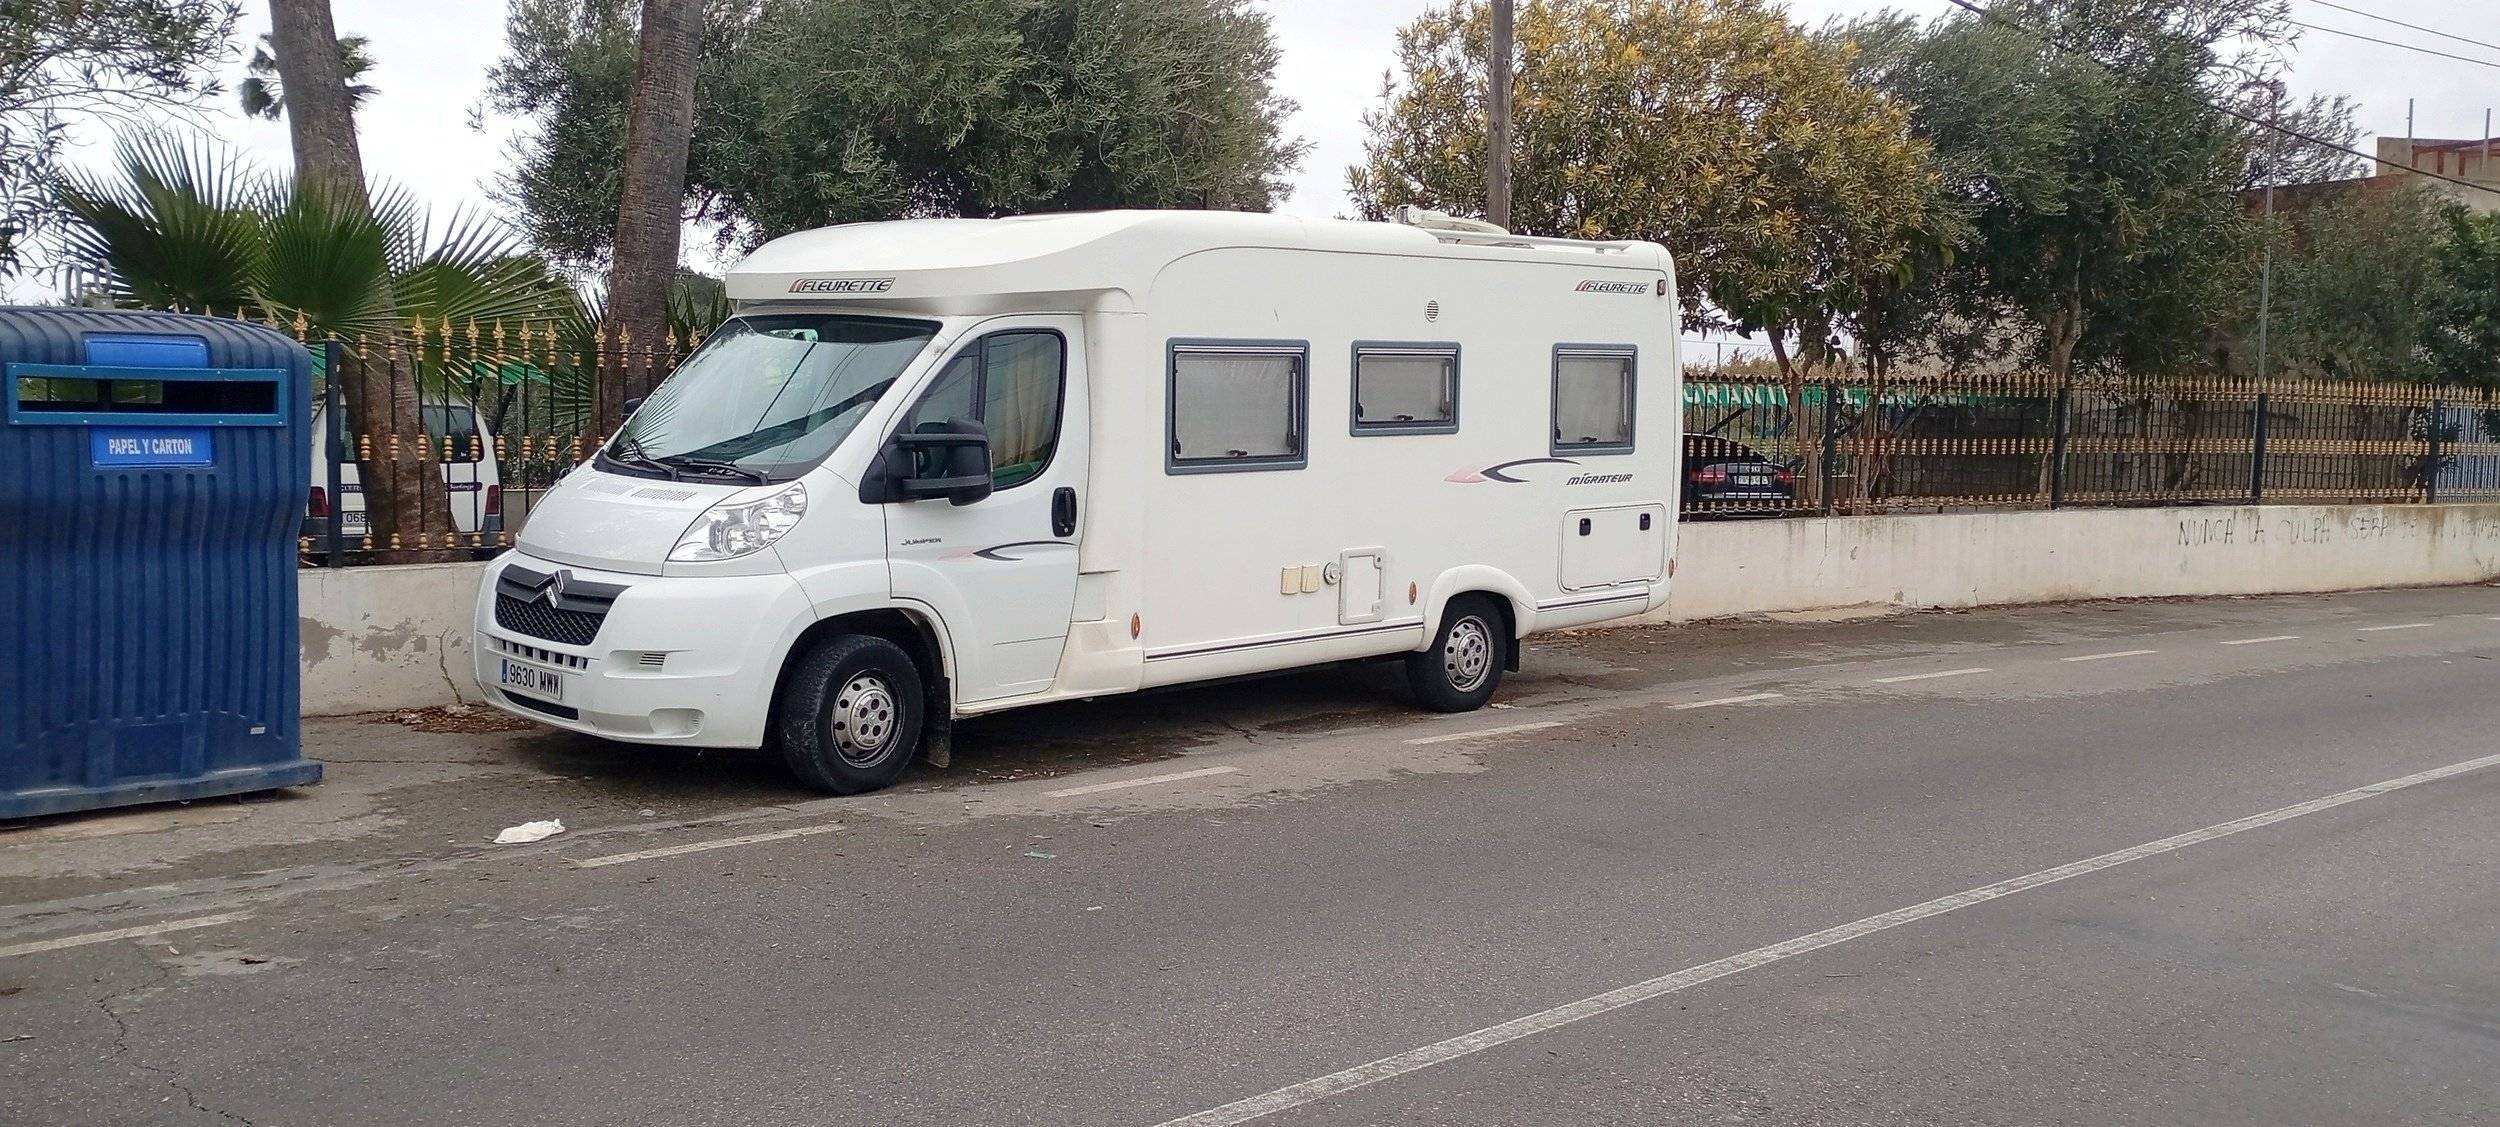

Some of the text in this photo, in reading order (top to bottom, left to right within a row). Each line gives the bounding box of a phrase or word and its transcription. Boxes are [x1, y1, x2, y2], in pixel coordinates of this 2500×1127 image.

[800, 279, 893, 292] FLEURETTE
[1585, 282, 1649, 294] FLEURETTE
[109, 438, 192, 455] PAPEL Y CARTON
[509, 664, 535, 688] 9630
